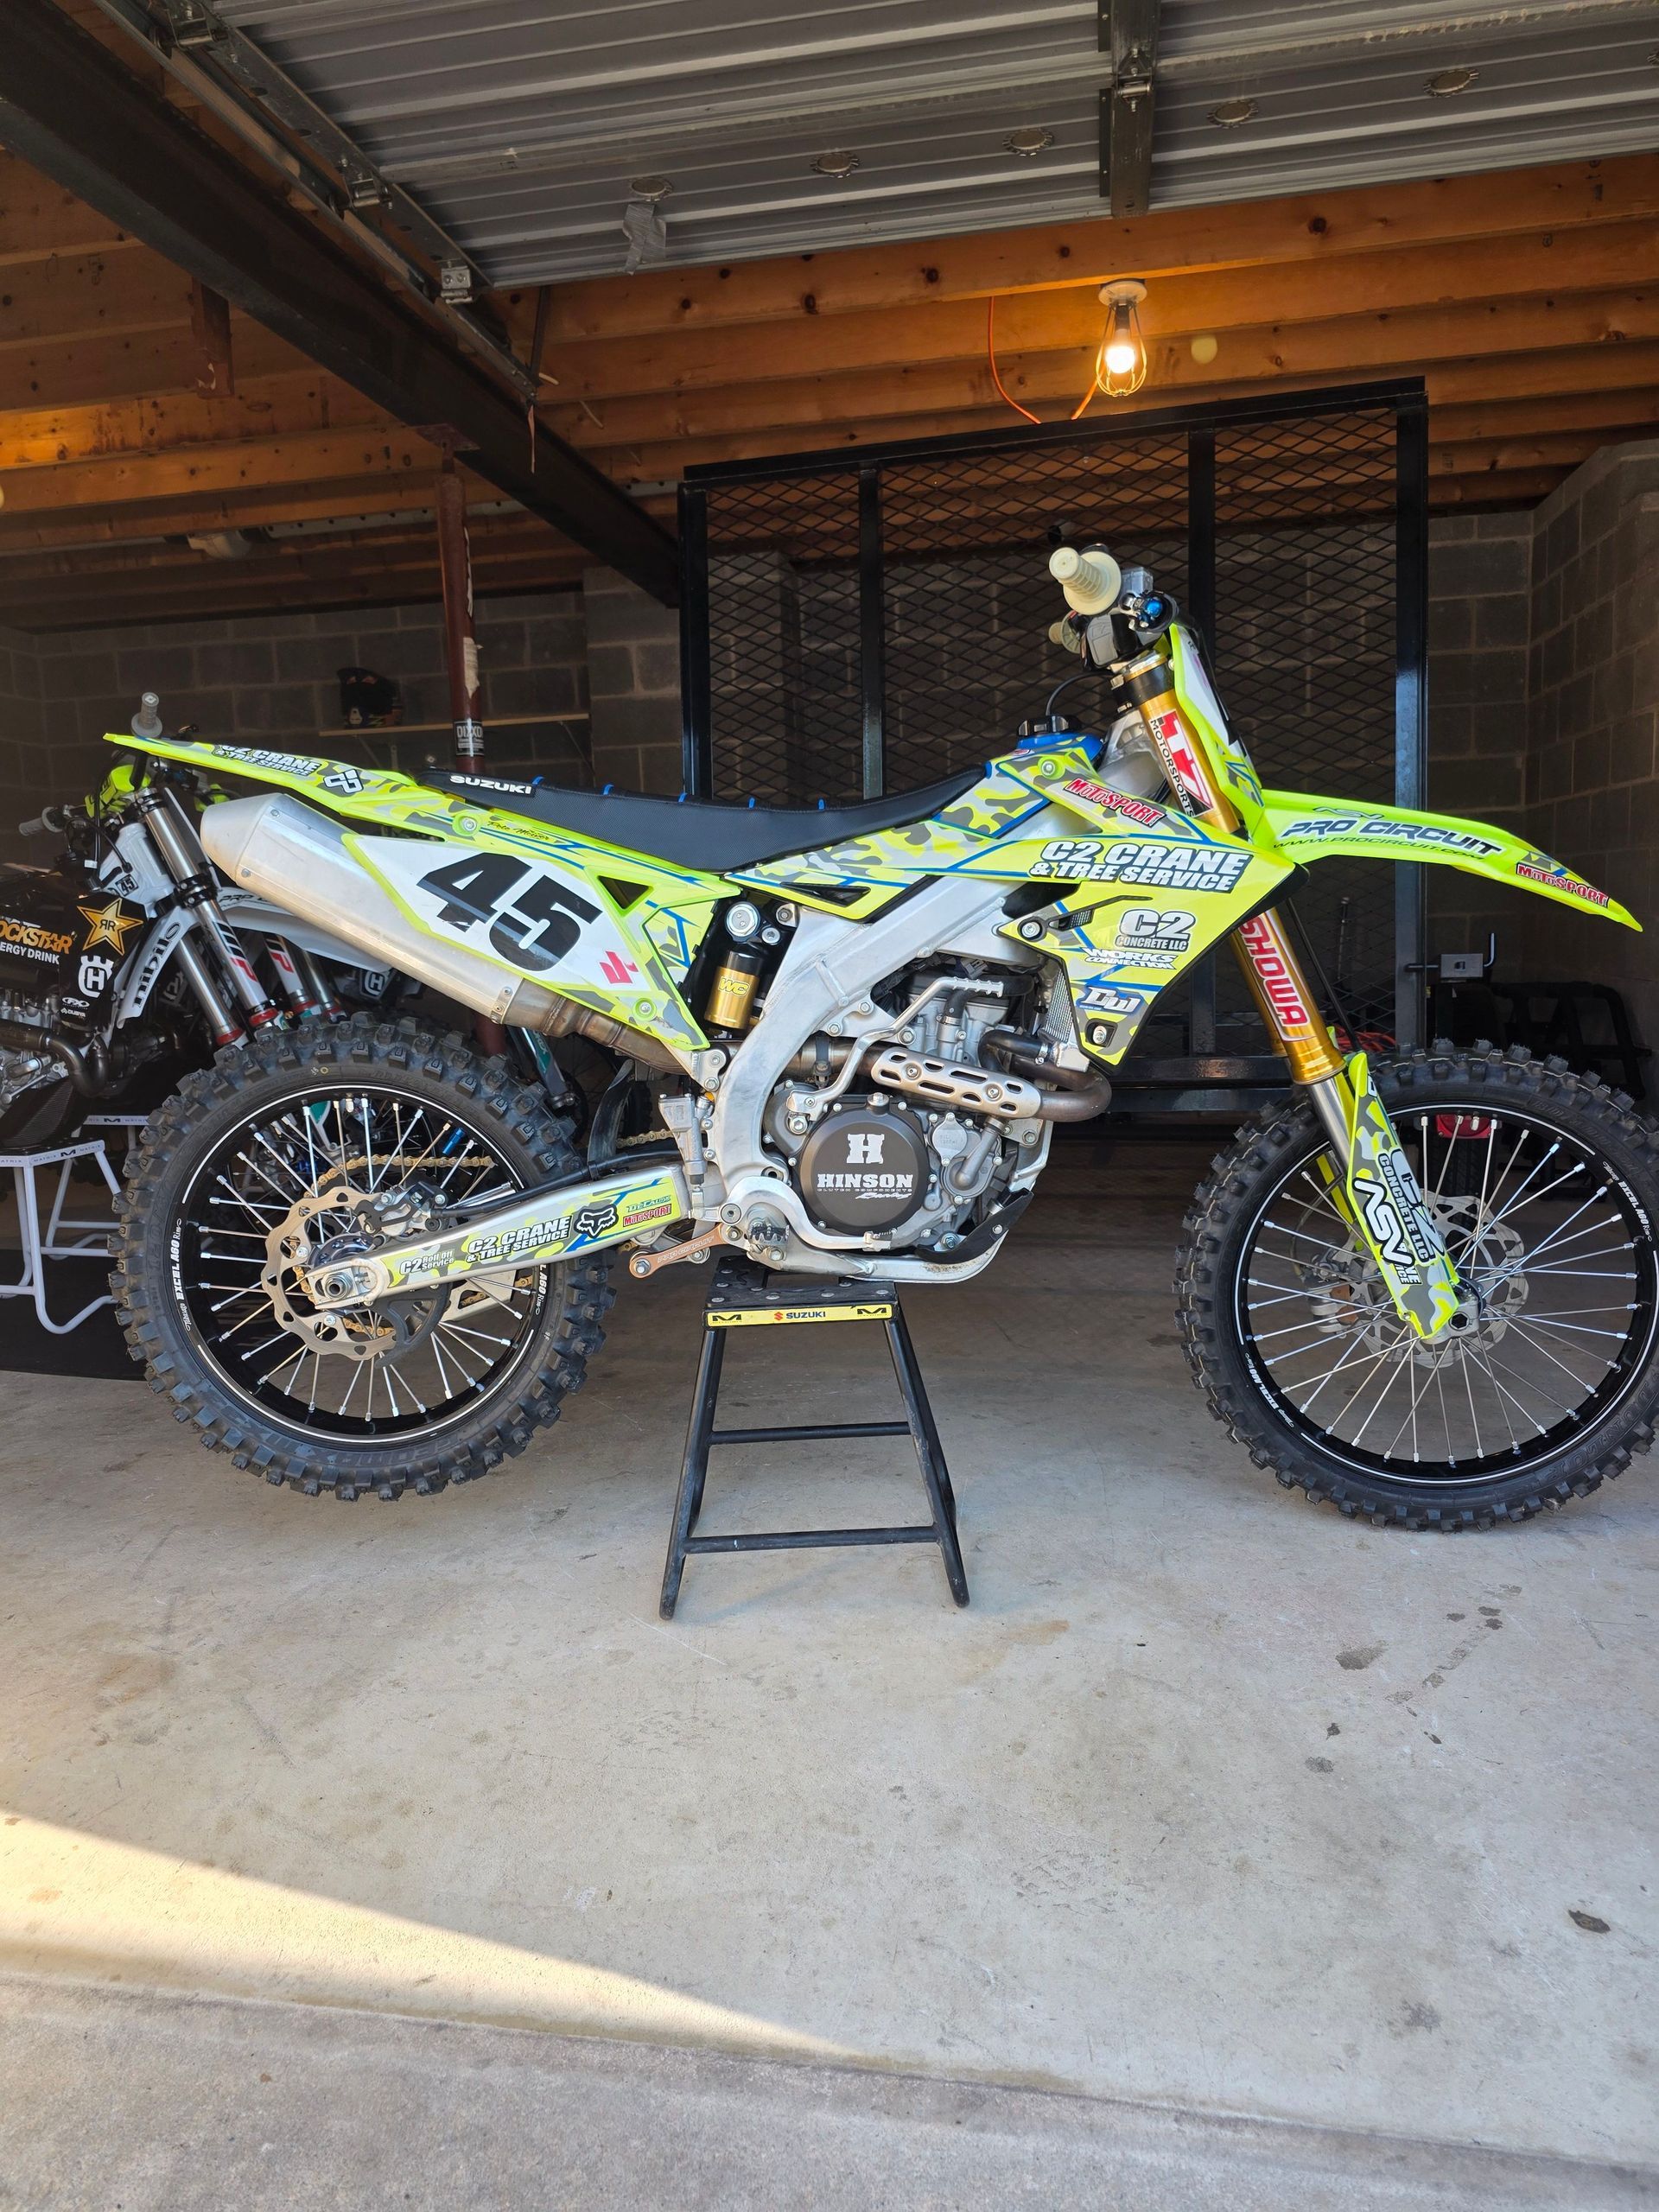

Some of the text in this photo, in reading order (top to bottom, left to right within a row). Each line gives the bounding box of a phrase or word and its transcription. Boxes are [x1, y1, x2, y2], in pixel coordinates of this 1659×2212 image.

[227, 752, 258, 766] TREE
[257, 759, 312, 777] SERVICE
[253, 749, 321, 772] CRANE
[1150, 719, 1195, 817] MOTORSPORTS
[450, 775, 532, 794] SUZUKI
[1281, 820, 1502, 855] PRO CIRCUIT
[1041, 841, 1254, 875] C2 CRANE
[120, 878, 135, 893] 45
[1030, 862, 1236, 892] & TREE SERVICE
[416, 852, 603, 971] 45
[1120, 909, 1196, 939] C2
[0, 919, 73, 955] OCKSTAR
[1116, 936, 1188, 950] CONCRETE LLC
[0, 941, 60, 964] ERGY DRINK
[1082, 948, 1178, 963] WORKS
[1085, 957, 1176, 969] CONNECTION
[1238, 916, 1310, 1027] SHOWA
[718, 976, 750, 996] WC
[847, 1134, 885, 1164] H
[817, 1173, 913, 1188] HINSON
[1618, 1181, 1639, 1208] EXCEL
[1378, 1153, 1417, 1236] CONCRETE
[1411, 1235, 1431, 1263] LLC
[467, 1230, 569, 1262] & TREE SERVICE
[468, 1217, 572, 1253] C2 CRANE
[170, 1240, 180, 1262] A60
[401, 1260, 423, 1274] C2
[423, 1254, 441, 1264] Roll
[422, 1257, 454, 1271] Service
[172, 1263, 185, 1300] EXCEL
[538, 1272, 547, 1294] A60
[785, 1311, 826, 1319] SUZUKI
